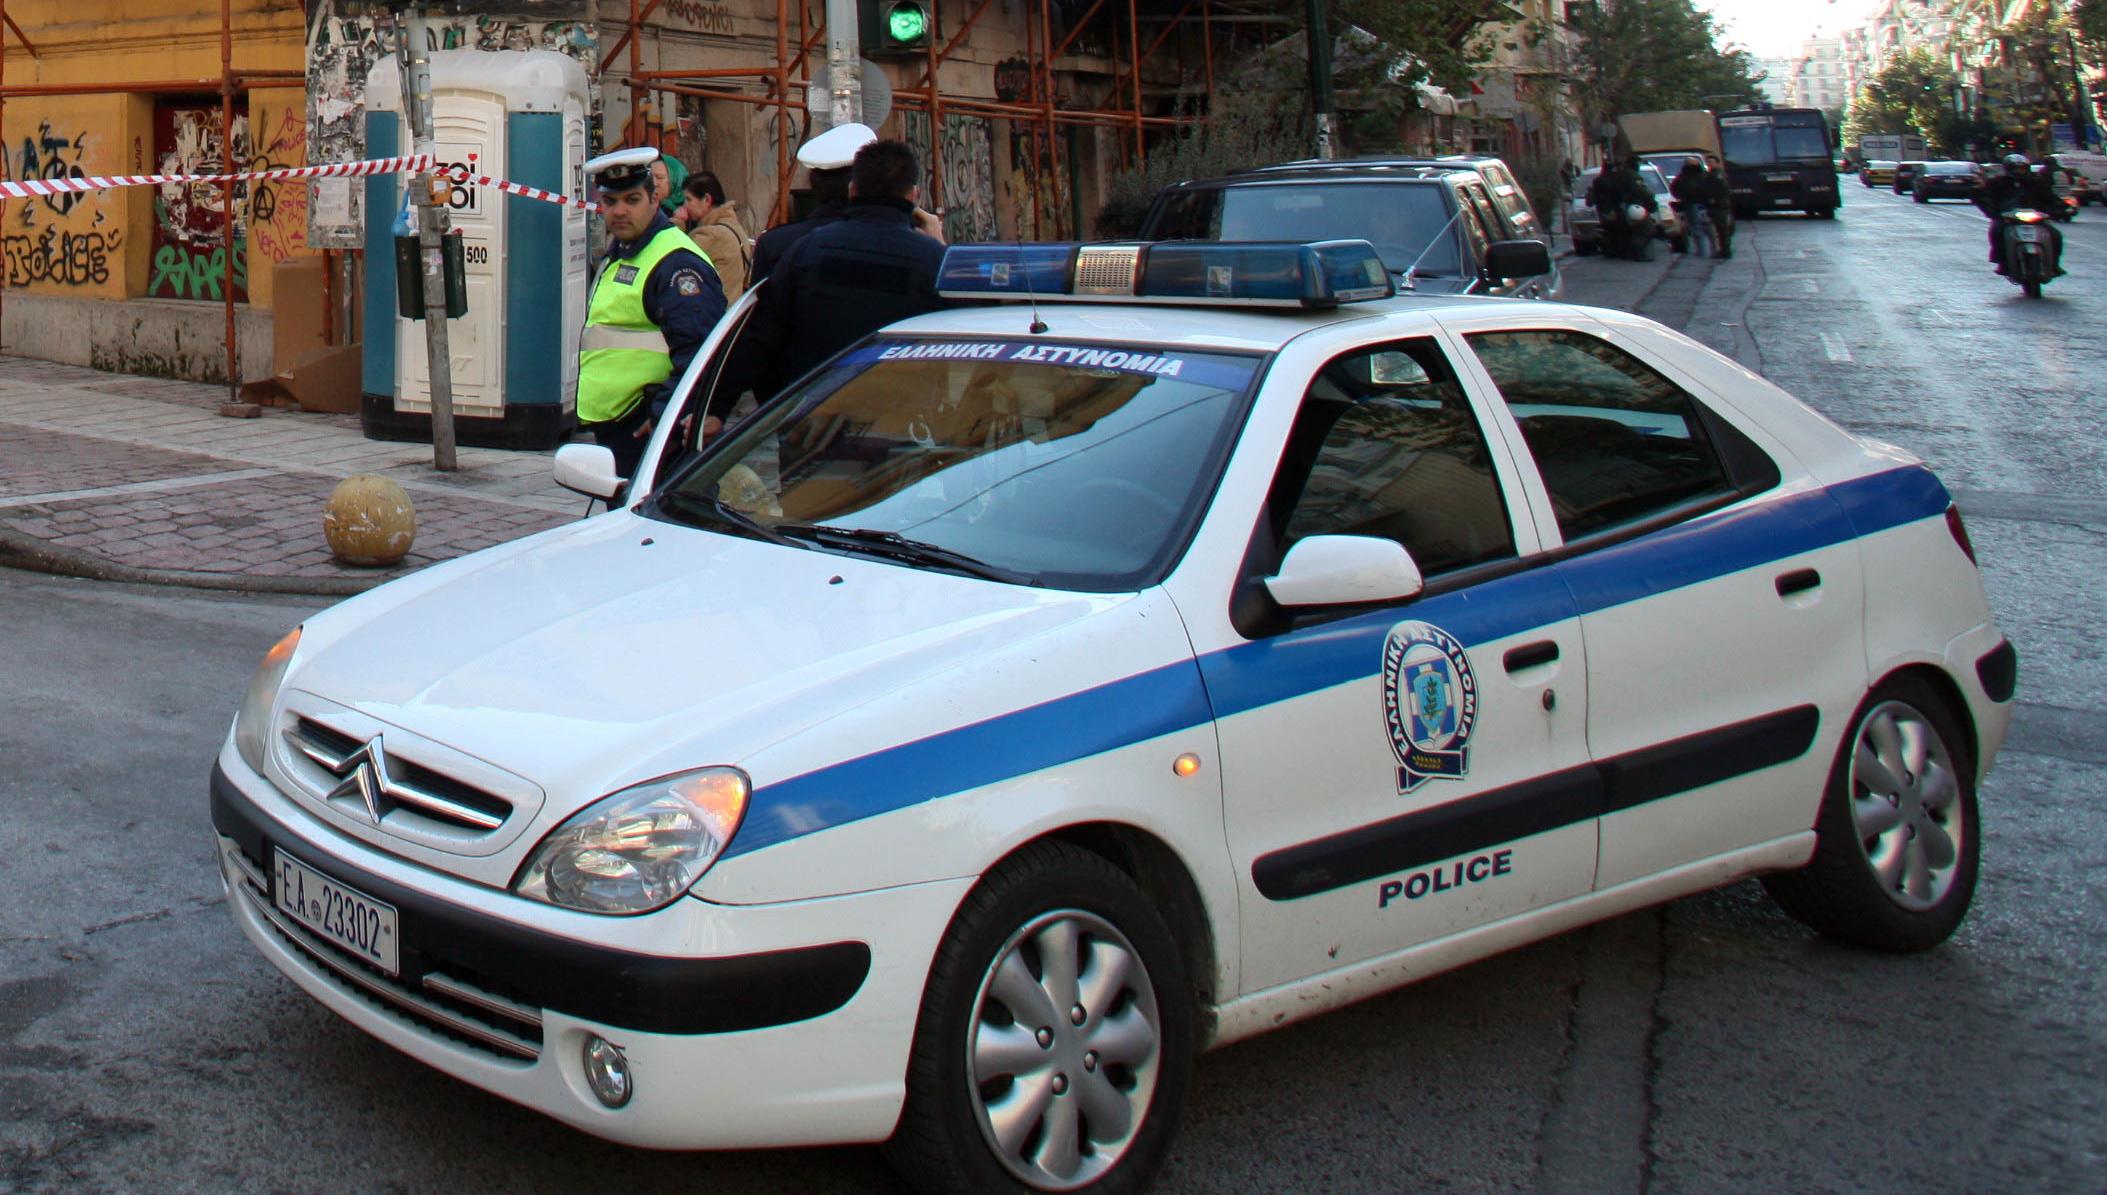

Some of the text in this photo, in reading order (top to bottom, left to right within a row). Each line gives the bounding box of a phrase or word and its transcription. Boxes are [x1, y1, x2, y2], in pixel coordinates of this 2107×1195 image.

[878, 344, 1185, 377] ΕΛΛΗΝΙΚΗ ΑΣΤΥΝΟΜΙΑ
[1378, 849, 1513, 909] POLICE
[323, 884, 382, 959] 23302
